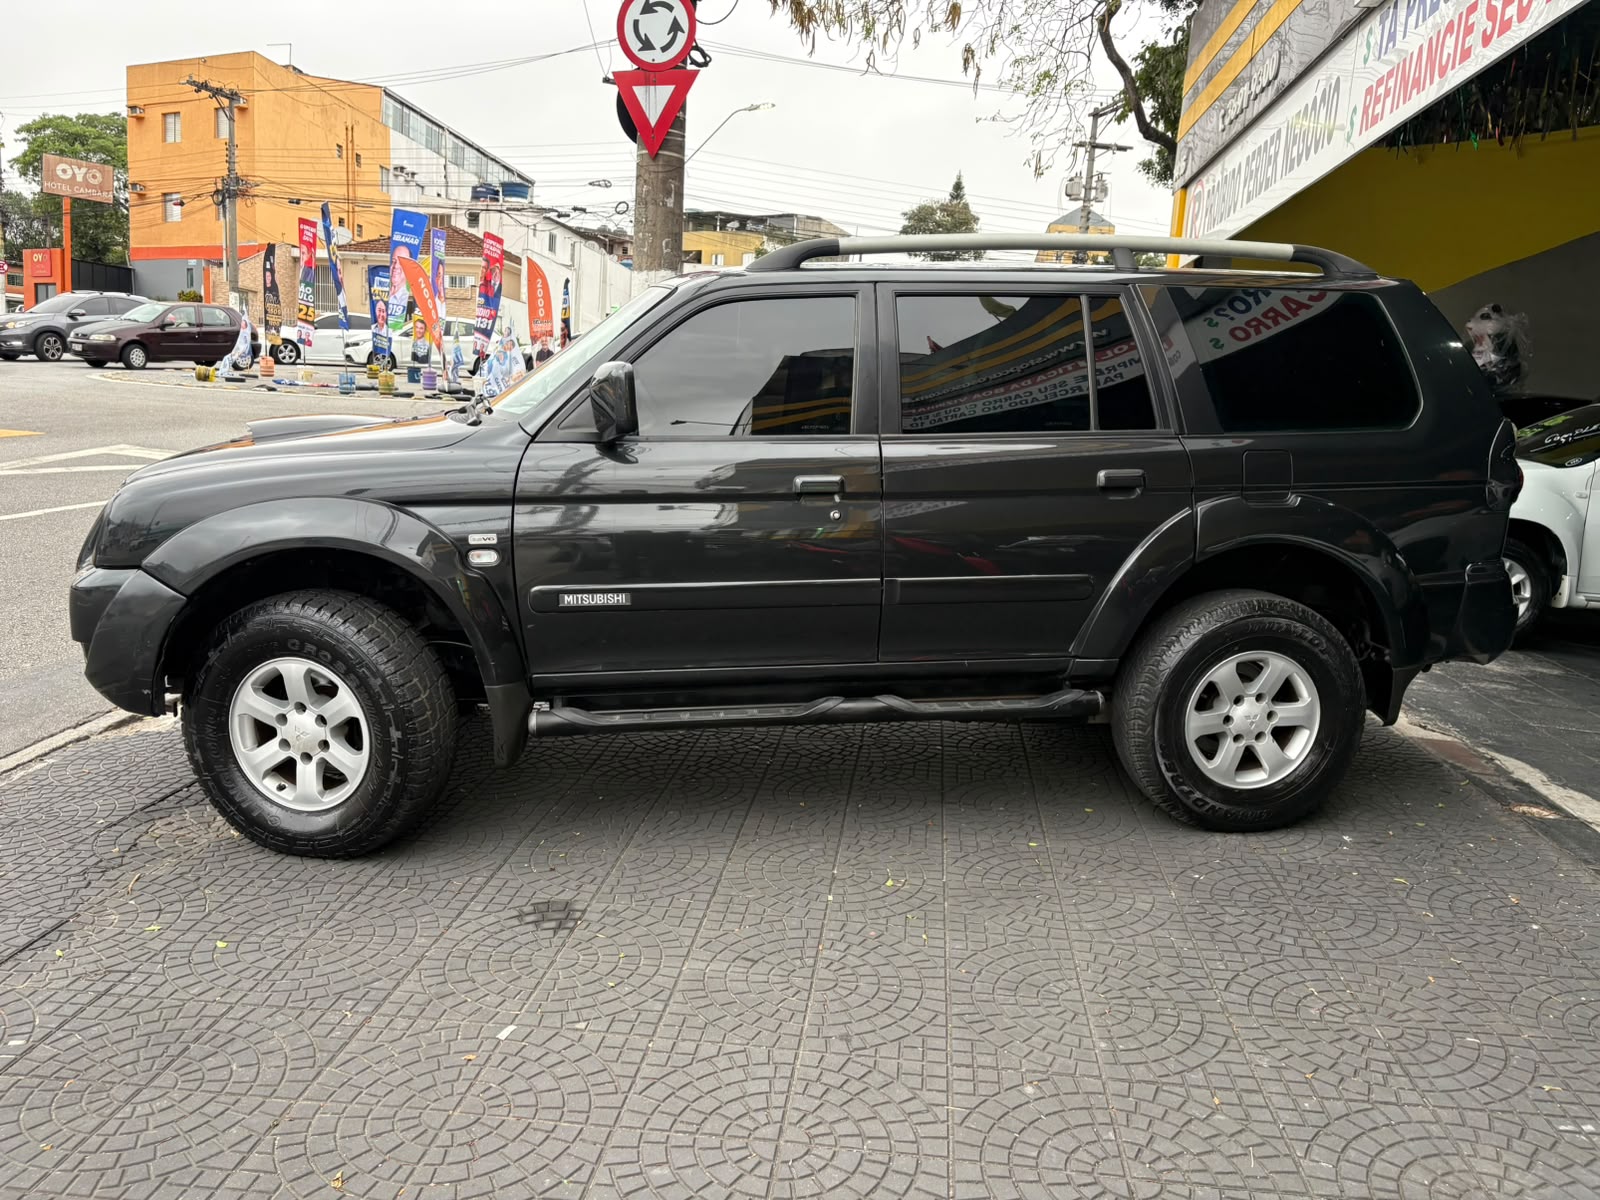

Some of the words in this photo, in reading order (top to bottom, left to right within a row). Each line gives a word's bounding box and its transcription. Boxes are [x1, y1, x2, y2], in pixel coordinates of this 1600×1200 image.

[1358, 0, 1479, 137] REFINANCIE
[1206, 161, 1242, 233] PROIBIDO
[1241, 127, 1282, 209] PERDER
[1280, 75, 1341, 181] NEGÓCIO
[55, 162, 103, 185] OYO
[44, 181, 72, 193] HOTEL
[299, 282, 313, 294] ÃO
[418, 277, 437, 320] 2000
[536, 278, 545, 317] 2000
[298, 304, 316, 322] 25
[564, 593, 626, 606] MITSUBISHI
